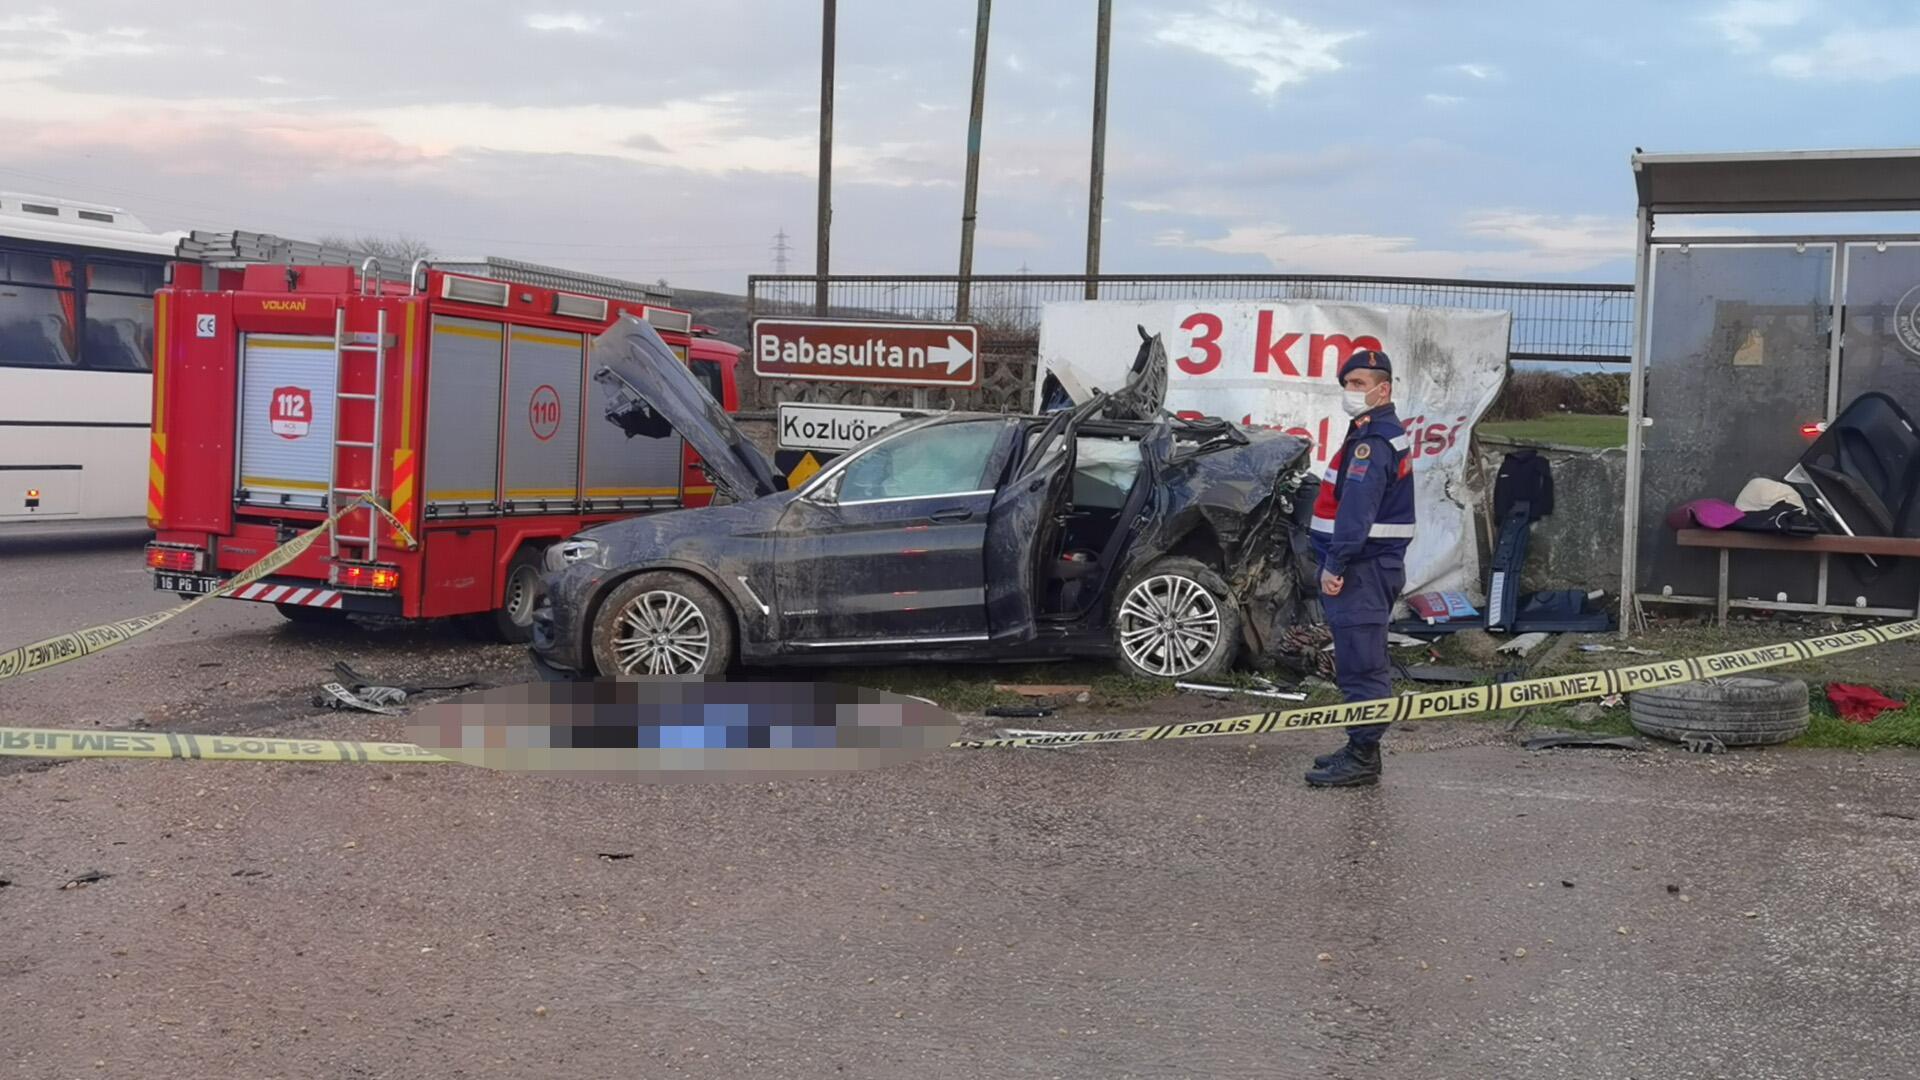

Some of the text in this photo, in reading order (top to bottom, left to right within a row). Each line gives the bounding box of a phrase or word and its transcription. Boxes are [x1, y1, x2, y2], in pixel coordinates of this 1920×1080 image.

[262, 300, 306, 310] VOLKAN
[760, 334, 925, 369] Babasultan
[1175, 309, 1383, 378] 3 km
[278, 394, 305, 417] 112
[533, 401, 557, 424] 110
[783, 415, 888, 441] Kozluör
[160, 576, 173, 590] 16
[178, 578, 192, 591] PG
